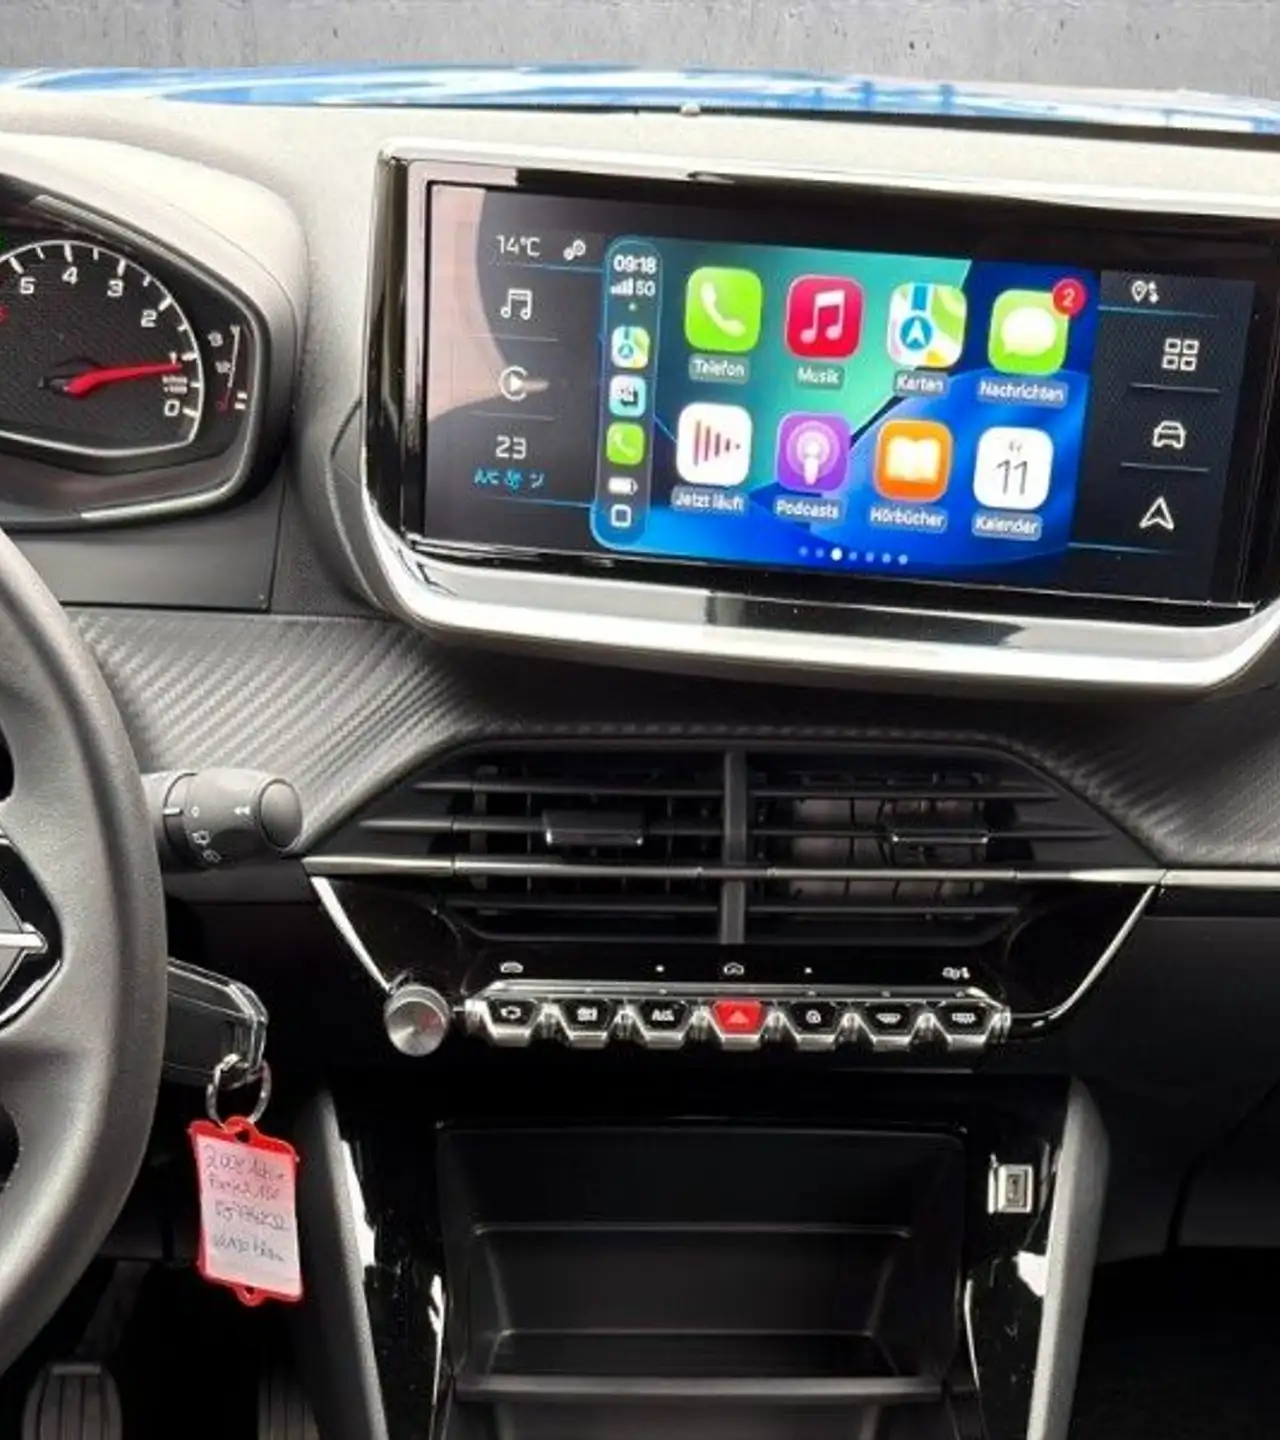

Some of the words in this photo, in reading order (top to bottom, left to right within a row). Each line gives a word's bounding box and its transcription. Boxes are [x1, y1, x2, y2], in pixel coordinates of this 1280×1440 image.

[496, 235, 540, 257] 14°C
[613, 254, 657, 274] 09:18
[62, 266, 78, 284] 4
[20, 277, 36, 294] 5
[107, 280, 124, 297] 3
[1063, 288, 1074, 307] 2
[141, 310, 157, 328] 2
[693, 359, 745, 378] Telefon
[797, 365, 840, 384] Musik
[895, 374, 944, 392] Karten
[979, 379, 1064, 402] Nachrichten
[164, 399, 180, 417] 0
[496, 435, 526, 459] 23
[995, 459, 1029, 495] 11
[675, 490, 710, 508] Jetzt
[712, 492, 744, 511] läuft
[776, 499, 839, 519] Podcasts
[870, 506, 945, 528] Hörbücher
[975, 516, 1037, 535] Kalender
